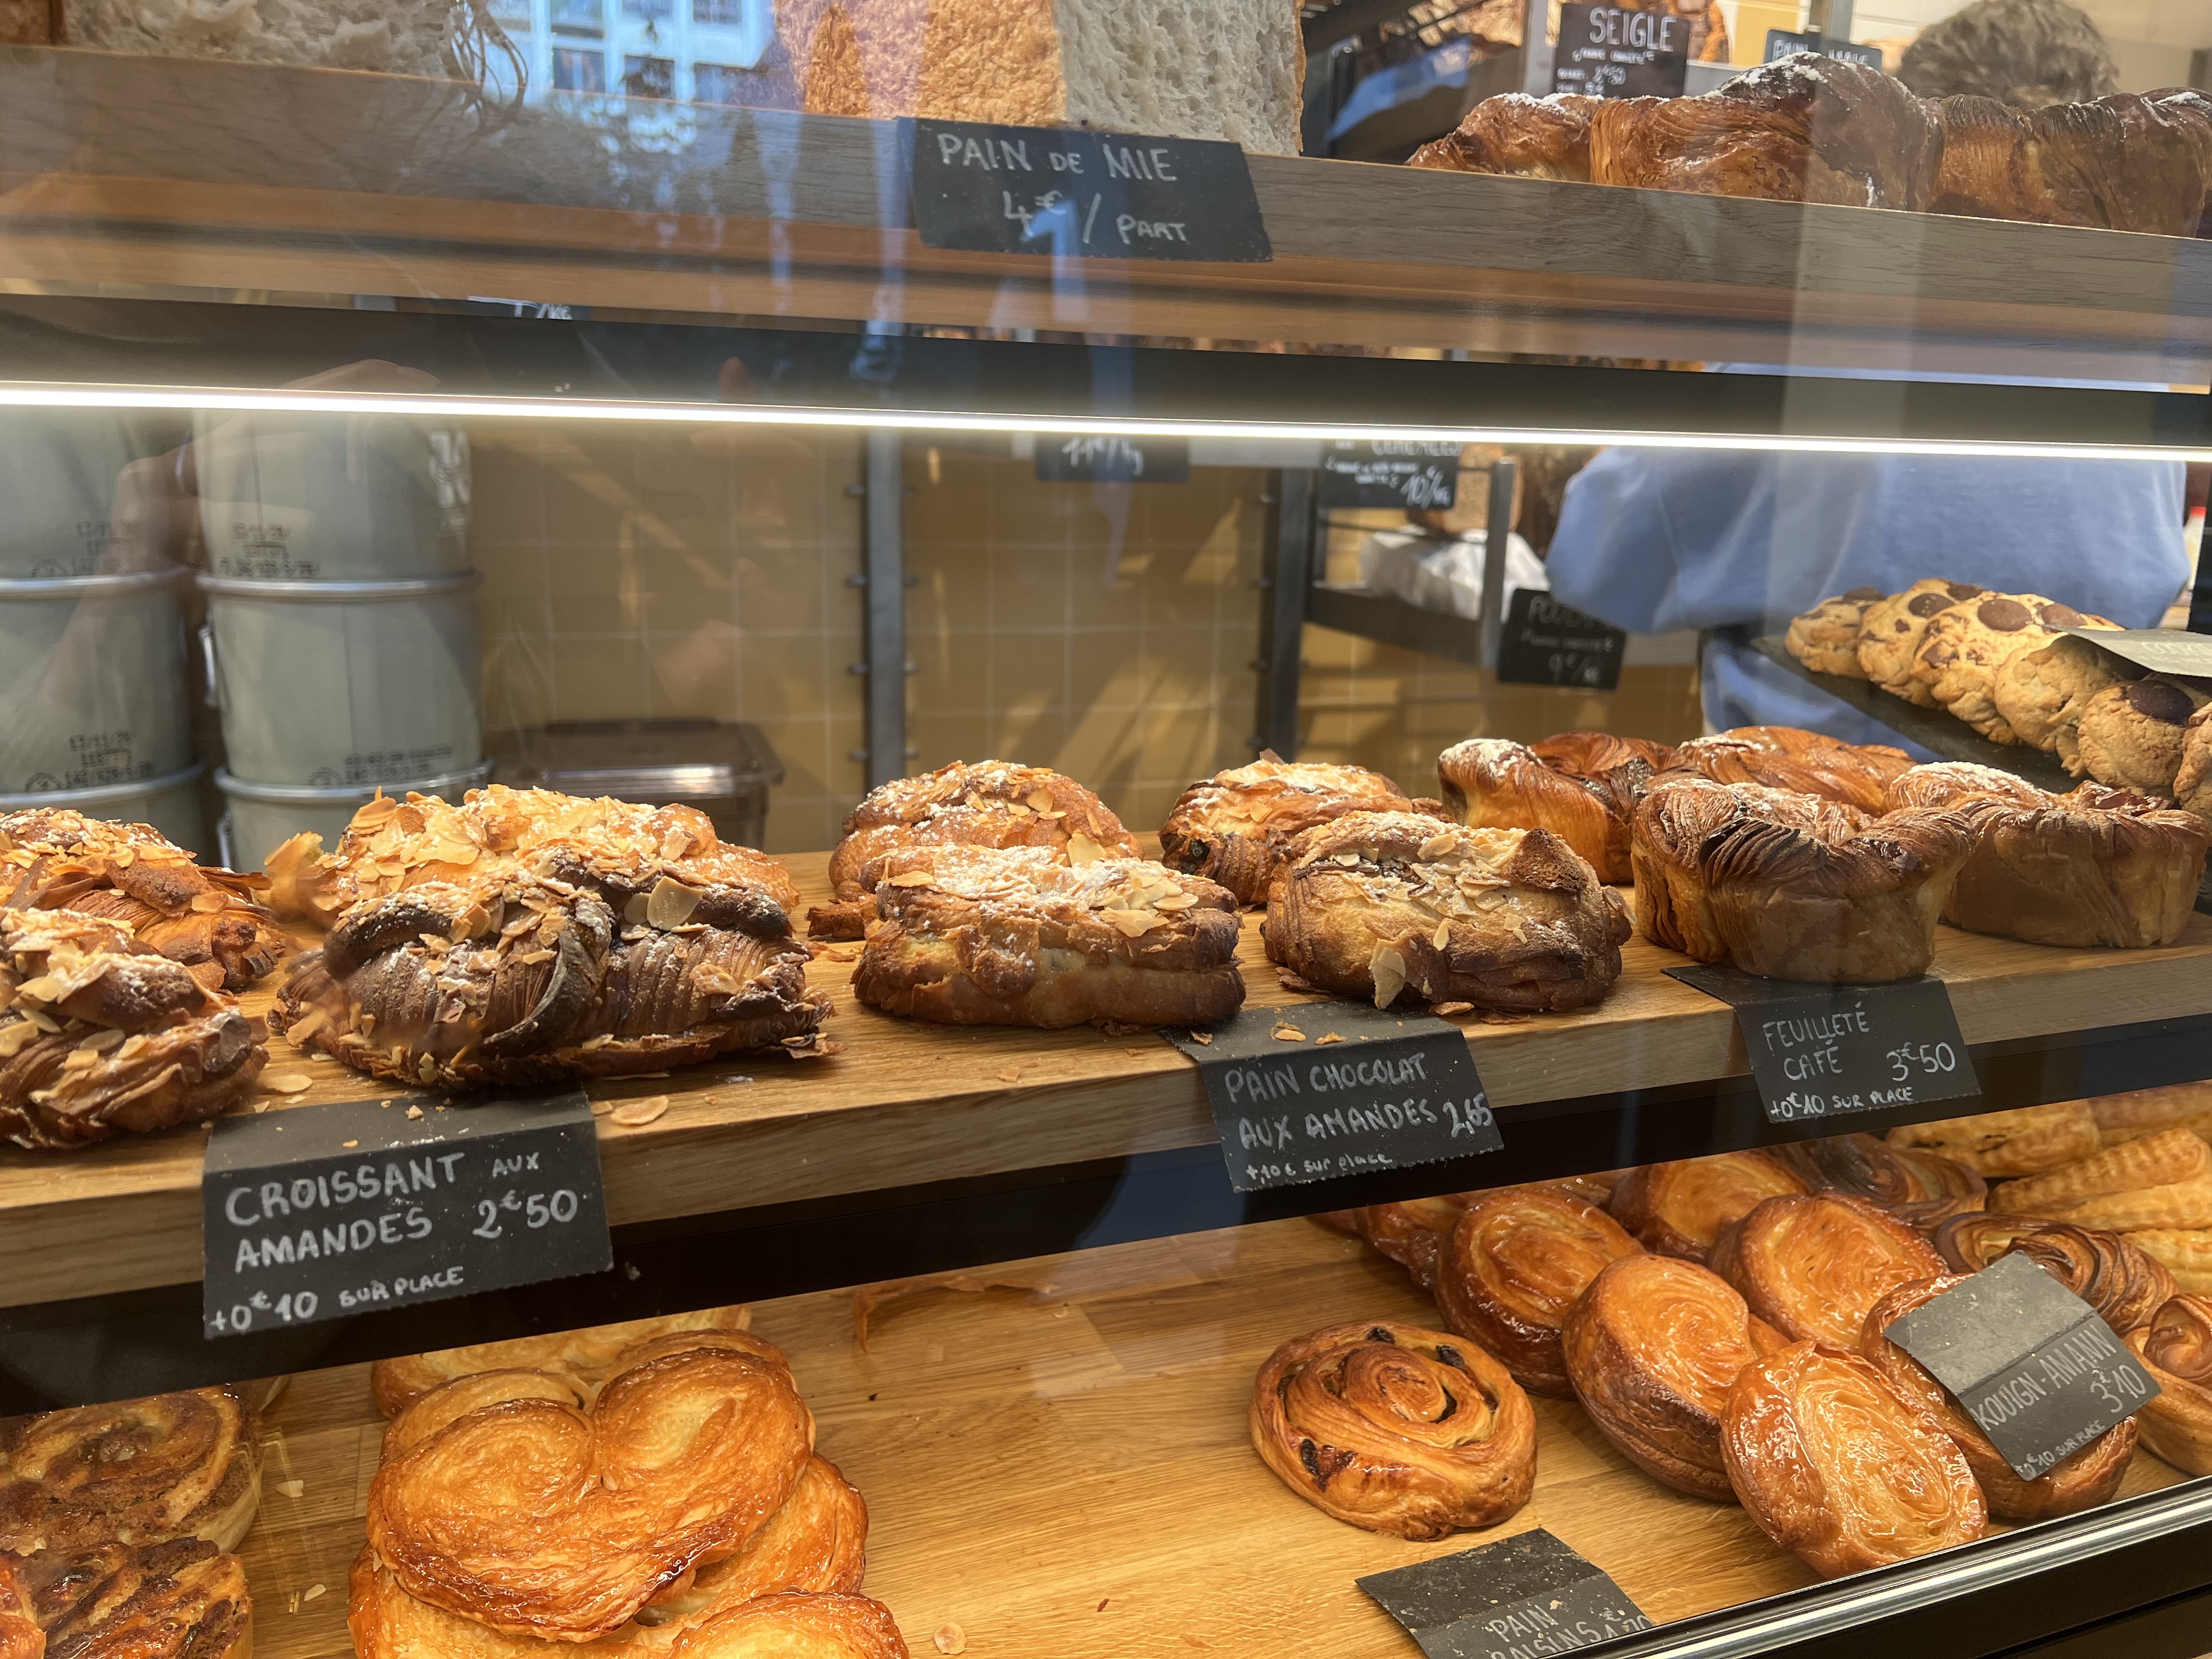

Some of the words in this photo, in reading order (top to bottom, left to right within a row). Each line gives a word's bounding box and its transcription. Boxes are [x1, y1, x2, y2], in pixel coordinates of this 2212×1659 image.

[1589, 7, 1677, 52] SEIGLE
[937, 133, 1032, 172] PAIN
[1102, 143, 1178, 182] MIE
[1116, 215, 1190, 245] PART
[1762, 1000, 1870, 1051] FEUILLETÉ
[1224, 1063, 1301, 1103] PAIN
[1308, 1051, 1427, 1093] CHOCOLAT
[1783, 1039, 1843, 1081] CAFÉ
[1885, 1041, 1956, 1082] 3€50
[1833, 1094, 1864, 1109] SUR
[1869, 1086, 1914, 1105] PLACE
[1238, 1115, 1294, 1151] AUX
[1304, 1097, 1438, 1141] AMANDES
[1304, 1157, 1331, 1173] sur
[225, 1152, 465, 1227] CROISSANT
[491, 1152, 540, 1178] AUX
[234, 1206, 433, 1274] AMANDES
[471, 1188, 579, 1239] 2€50
[338, 1278, 391, 1308] SUR
[393, 1265, 465, 1297] PLACE
[2056, 1438, 2079, 1456] SUR
[1488, 1604, 1559, 1643] PAIN
